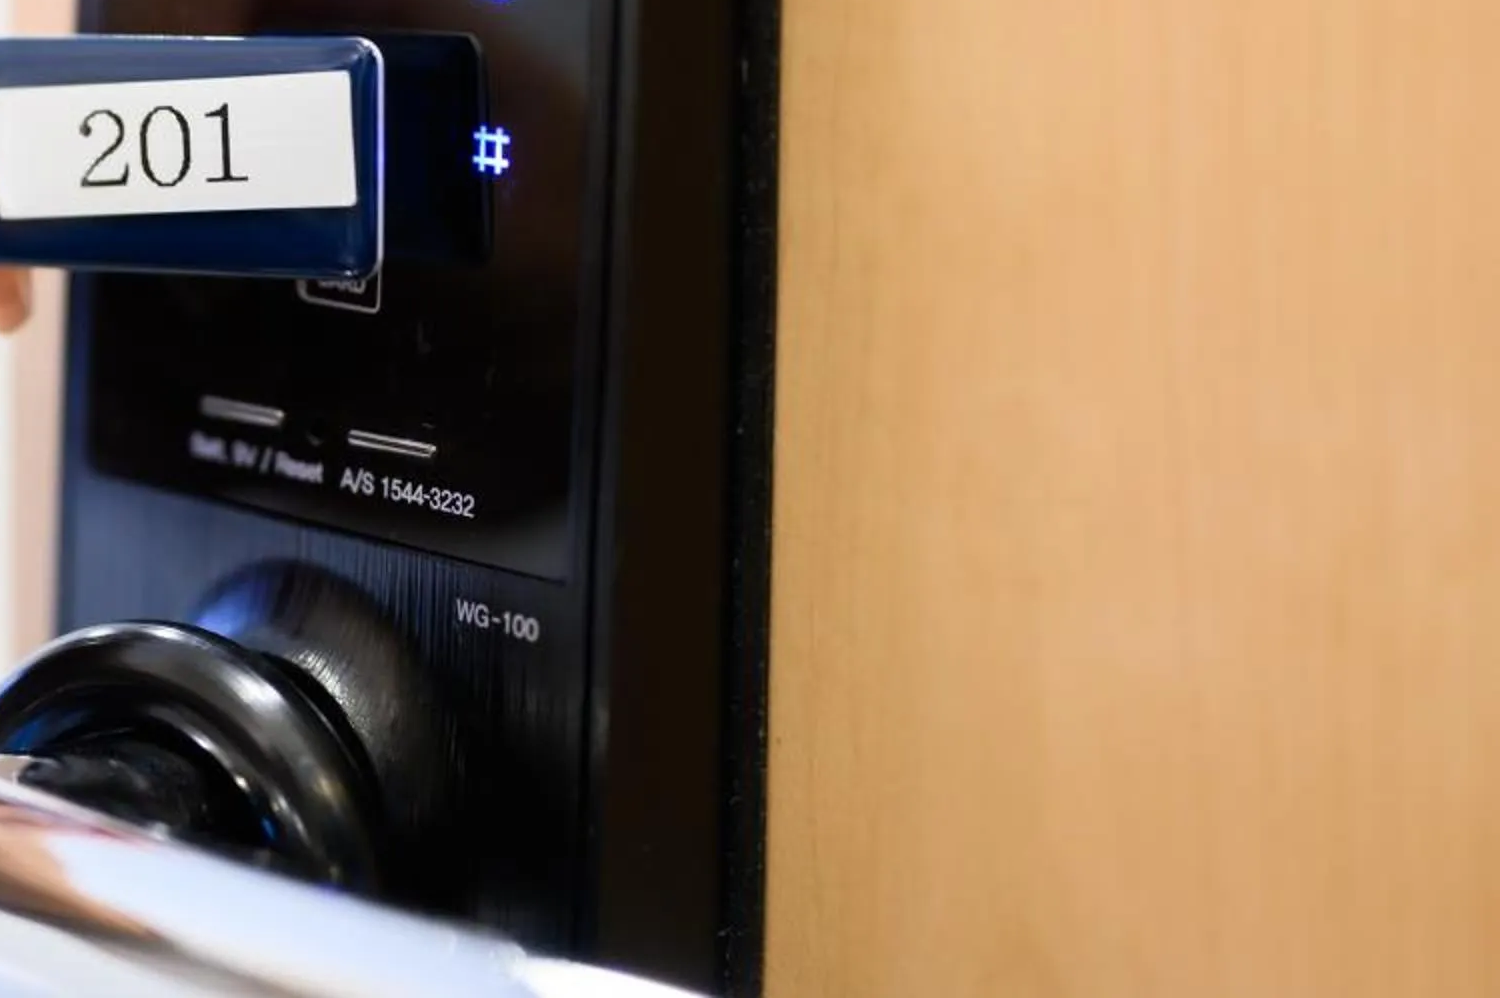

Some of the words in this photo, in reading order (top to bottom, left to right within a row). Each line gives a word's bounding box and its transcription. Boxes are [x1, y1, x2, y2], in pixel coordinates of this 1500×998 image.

[79, 103, 248, 187] 201
[341, 468, 375, 496] A/S
[381, 476, 476, 518] 1544-3232
[456, 598, 539, 642] WG-100
